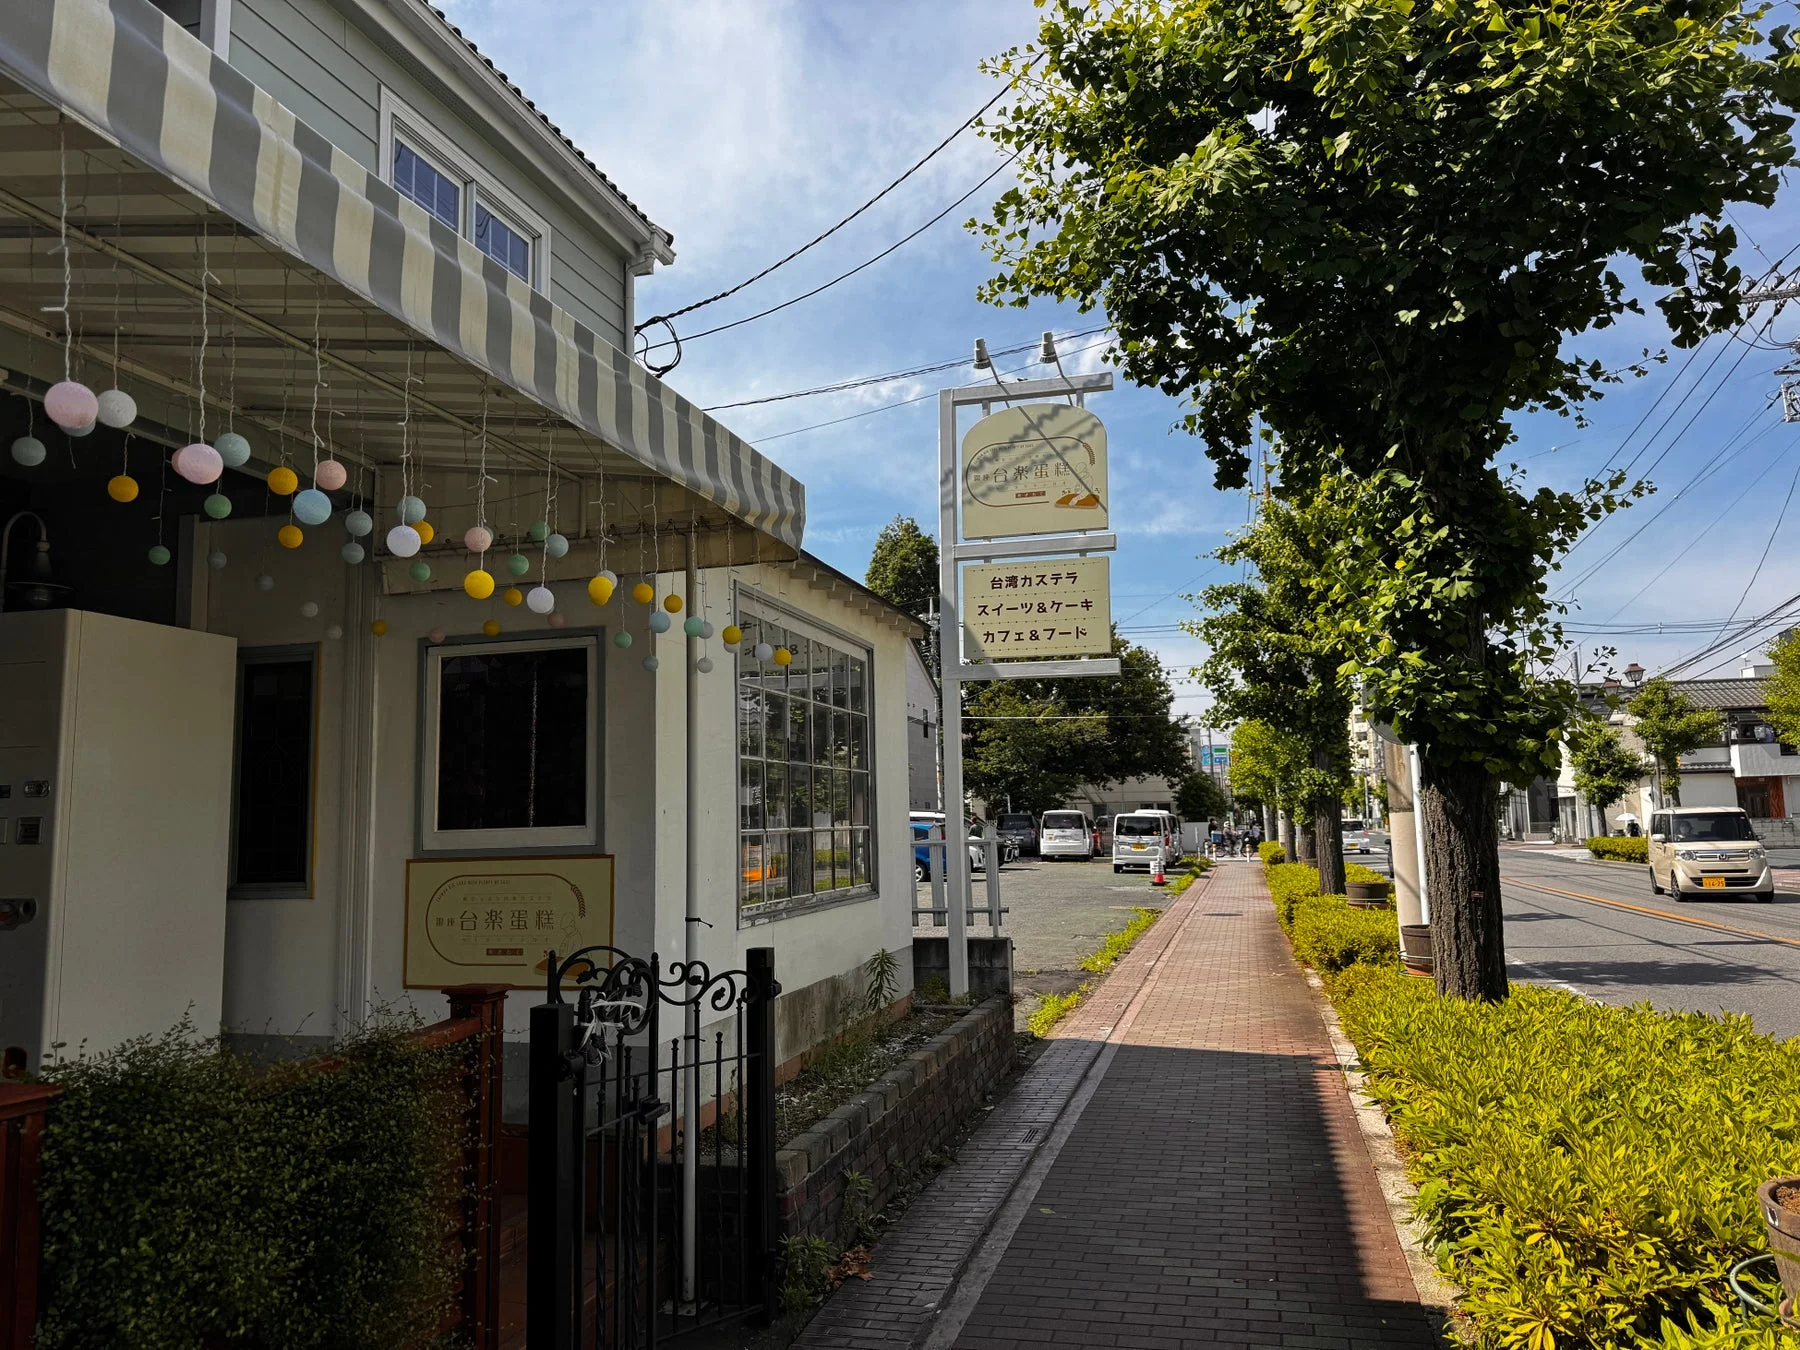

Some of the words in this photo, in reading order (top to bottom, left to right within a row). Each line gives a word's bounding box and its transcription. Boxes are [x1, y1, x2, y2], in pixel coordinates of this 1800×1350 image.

[992, 461, 1071, 483] 台楽蛋糕
[989, 572, 1079, 590] 台湾カステラ
[977, 598, 1094, 617] スイーツ&ケーキ
[983, 626, 1088, 645] カフェ&フード
[459, 909, 555, 931] 台楽蛋糕
